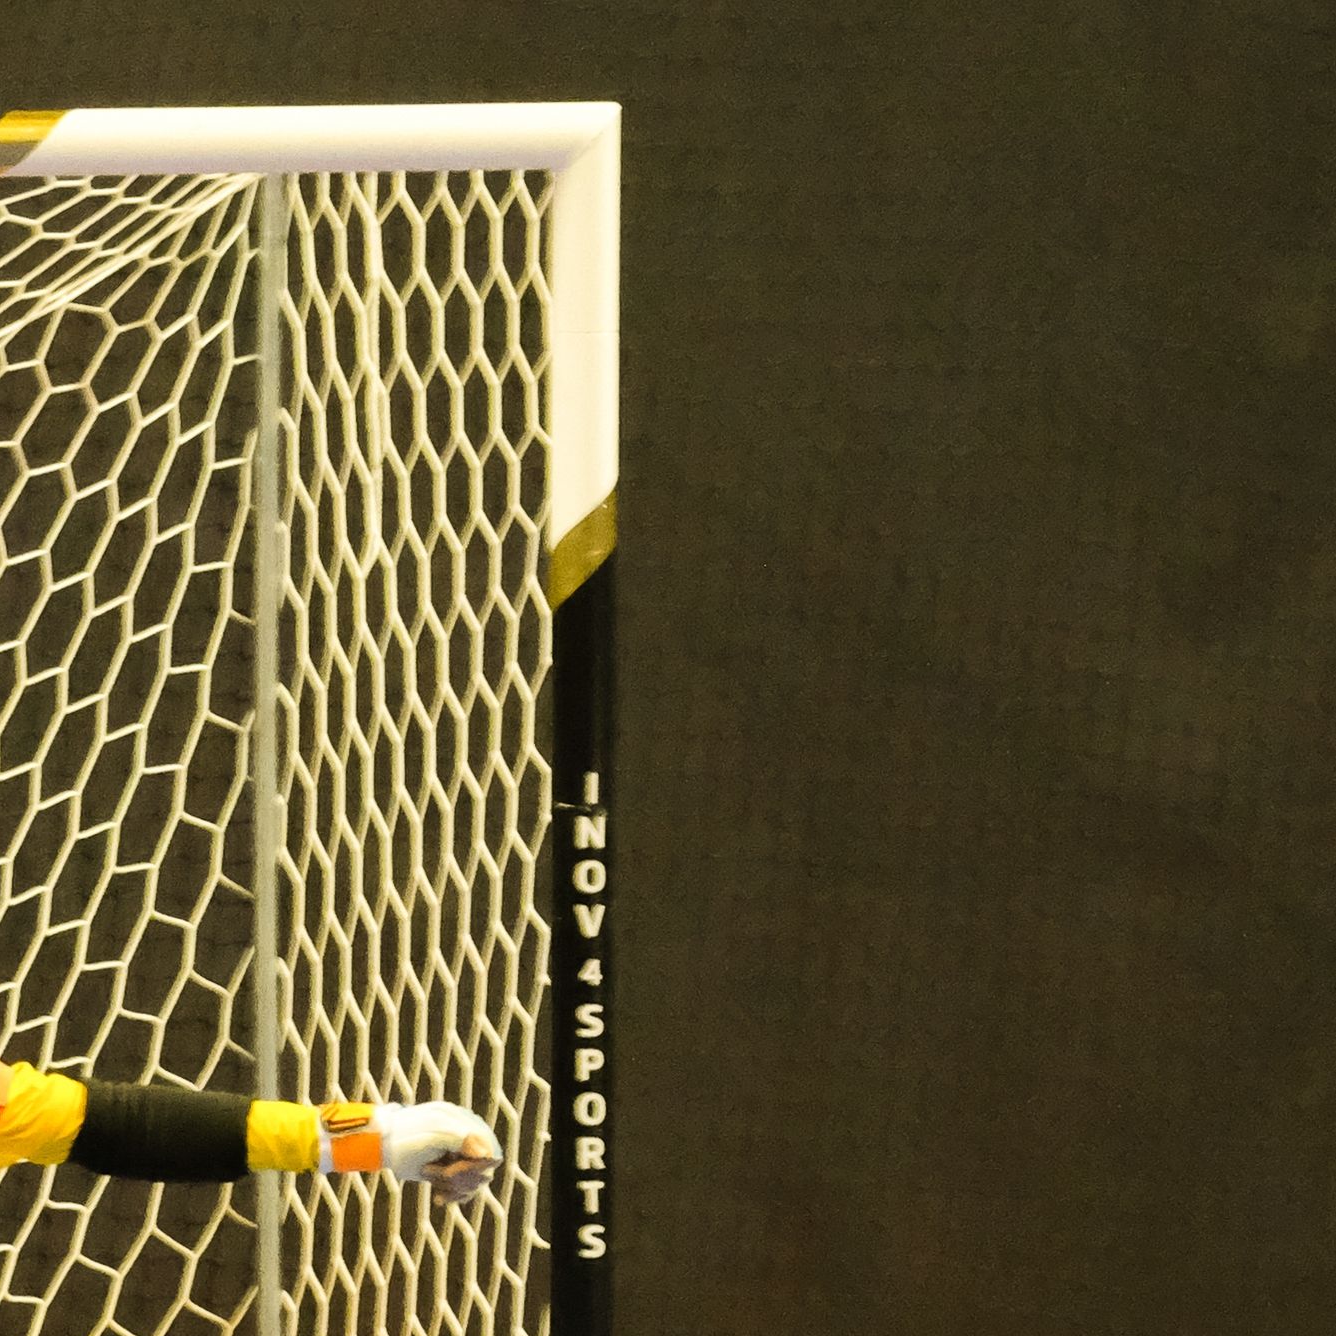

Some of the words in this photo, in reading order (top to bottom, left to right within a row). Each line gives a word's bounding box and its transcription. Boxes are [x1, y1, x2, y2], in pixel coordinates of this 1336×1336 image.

[572, 770, 607, 939] INOV
[577, 958, 604, 987] 4
[572, 1003, 607, 1260] SPORTS
